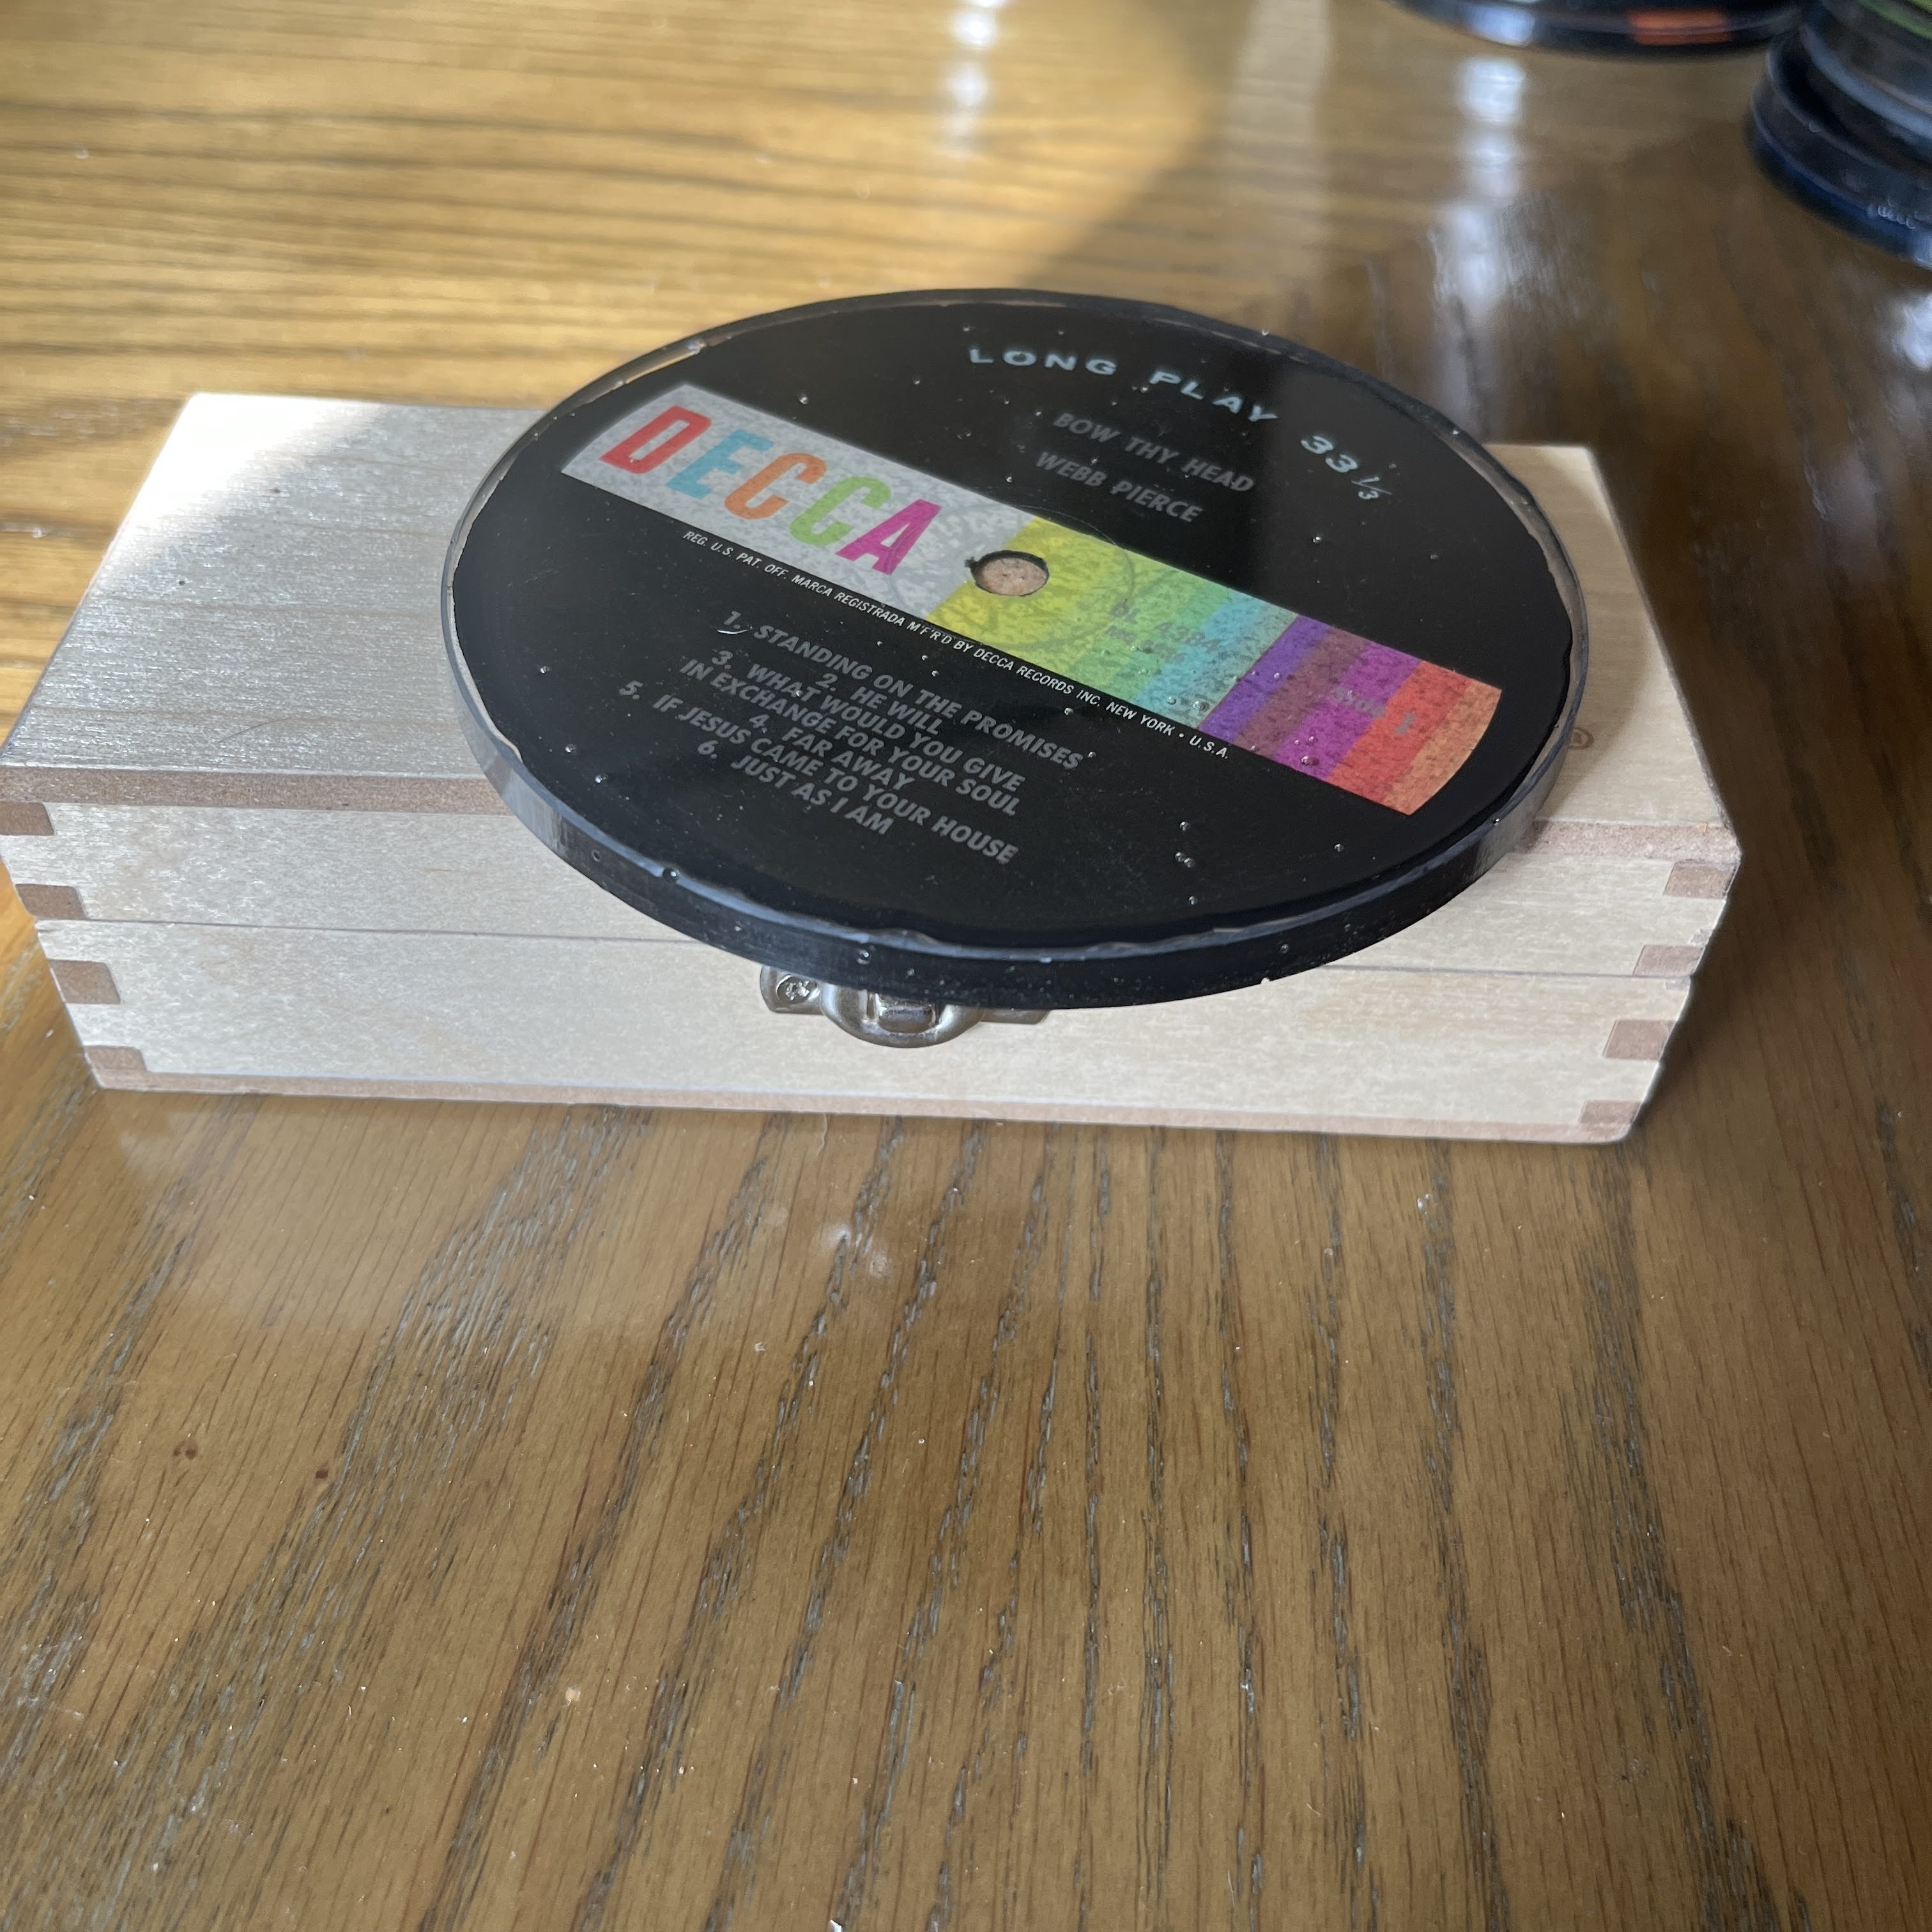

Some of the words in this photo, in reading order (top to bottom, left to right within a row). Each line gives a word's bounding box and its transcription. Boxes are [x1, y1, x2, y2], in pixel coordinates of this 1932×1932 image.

[969, 348, 1117, 375] LONG
[1149, 371, 1278, 422] PLAY
[599, 405, 942, 575] DECCA
[1036, 452, 1107, 486] WEBB
[1110, 480, 1203, 523] PIERCE
[1054, 413, 1121, 443] BOW
[1124, 436, 1181, 464] THY
[1182, 458, 1255, 492] HEAD
[683, 530, 707, 547] REG.
[710, 542, 734, 557] U.S.
[736, 552, 762, 569] PAT.
[764, 564, 790, 579] OFF.
[791, 574, 832, 597] MARCA
[834, 592, 905, 627] REGISTRADA
[953, 640, 975, 653] BY
[974, 648, 1015, 671] DECCA
[1016, 665, 1075, 695] RECORDS
[1076, 689, 1101, 707] INC.
[1105, 702, 1137, 720] NEW
[1140, 714, 1176, 736] YORK
[1188, 735, 1229, 760] U.S.A.
[753, 625, 873, 680] STANDING
[873, 674, 914, 698] ON
[914, 689, 962, 719] THE
[960, 709, 1084, 770] PROMISES
[815, 672, 839, 692] 2.
[850, 686, 887, 709] HE
[887, 700, 943, 735] WILL
[618, 680, 644, 700] 5.
[652, 694, 684, 713] IF
[677, 707, 751, 744] JESUS
[751, 737, 824, 777] CAME
[824, 767, 859, 792] TO
[862, 783, 931, 825] YOUR
[931, 815, 1019, 864] HOUSE
[679, 659, 714, 680] IN
[710, 671, 837, 734] EXCHANGE
[834, 725, 885, 756] FOR
[888, 746, 956, 786] YOUR
[955, 778, 1020, 816] SOUL
[712, 650, 734, 670] 3.
[746, 663, 822, 702] WHAT
[820, 695, 905, 739] WOULD
[908, 732, 963, 763] YOU
[963, 757, 1025, 792] GIVE
[749, 714, 770, 733] 4.
[781, 727, 833, 758] FAR
[831, 751, 916, 791] AWAY
[697, 740, 719, 760] 6.
[730, 755, 797, 788] JUST
[791, 782, 832, 806] AS
[830, 797, 848, 813] I
[844, 805, 894, 835] AM
